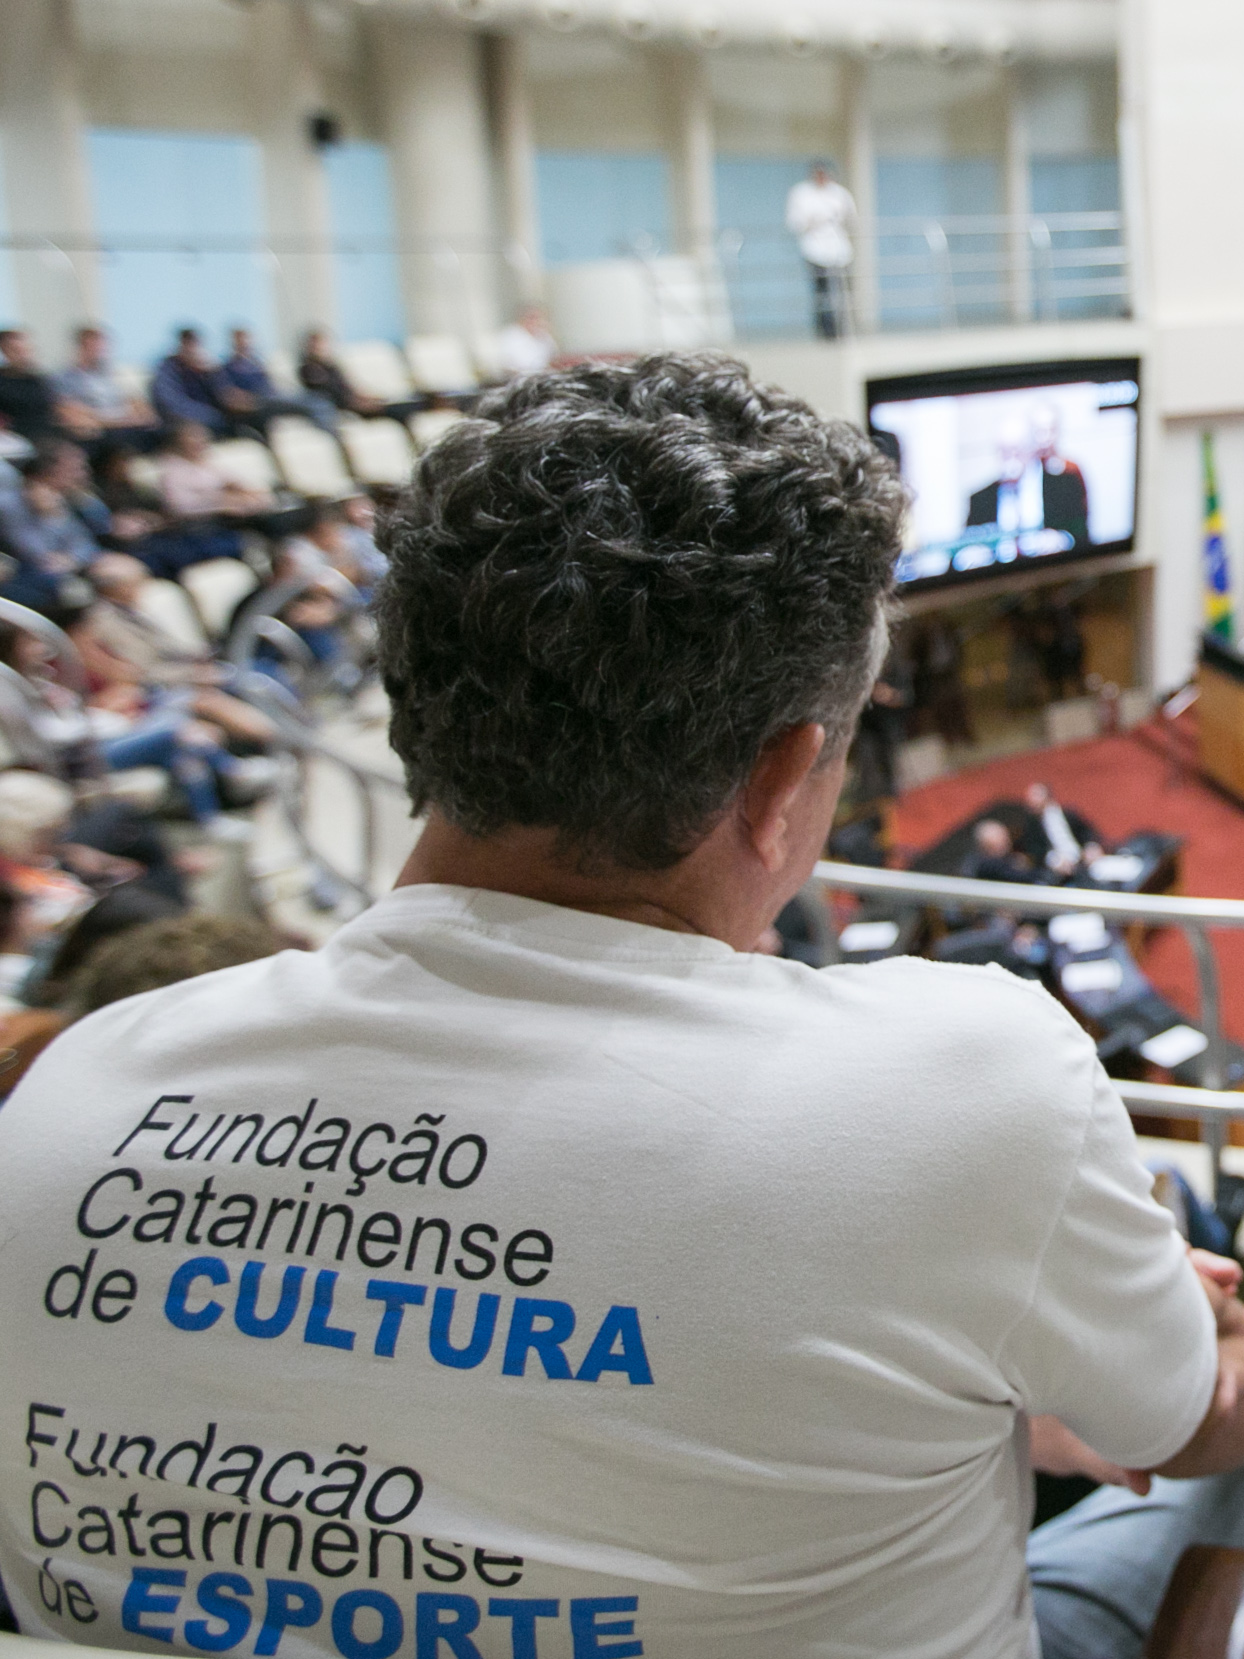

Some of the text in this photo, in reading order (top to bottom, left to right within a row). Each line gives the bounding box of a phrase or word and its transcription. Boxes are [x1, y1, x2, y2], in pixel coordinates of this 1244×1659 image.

[112, 1094, 488, 1198] Fundação
[76, 1167, 554, 1286] Catarinense
[43, 1248, 655, 1385] de CULTURA
[31, 1481, 525, 1587] Catarinense
[38, 1557, 644, 1659] de ESPORTE
